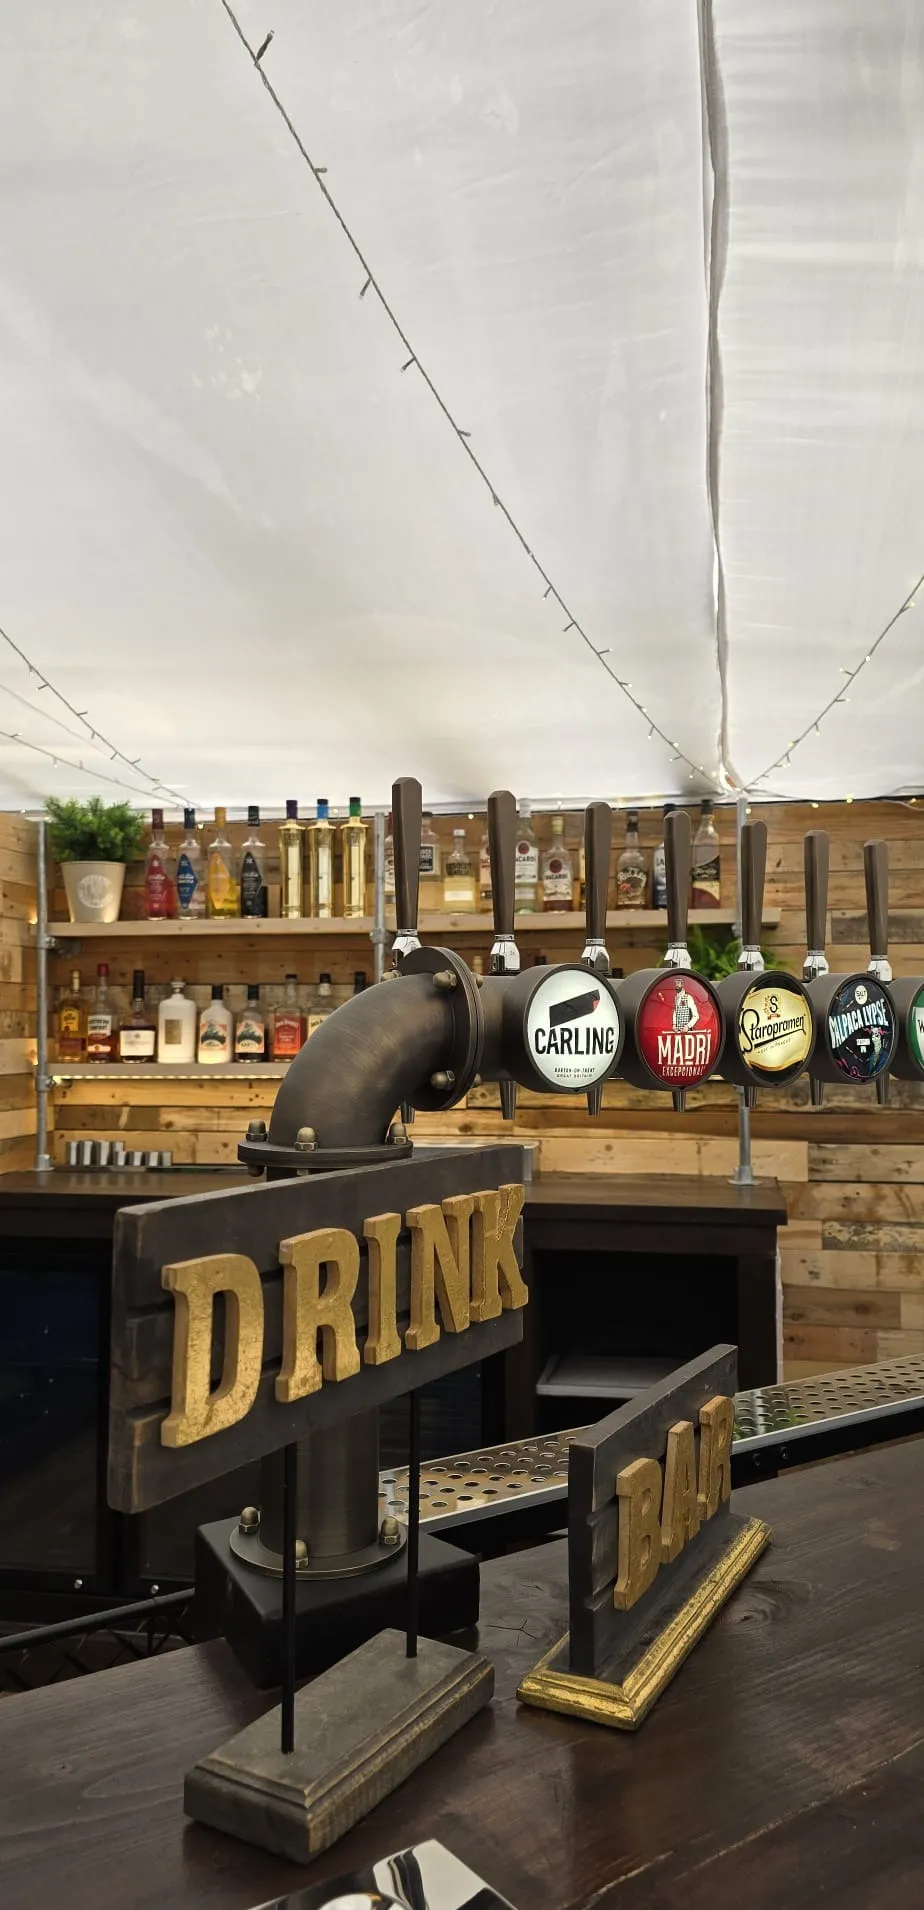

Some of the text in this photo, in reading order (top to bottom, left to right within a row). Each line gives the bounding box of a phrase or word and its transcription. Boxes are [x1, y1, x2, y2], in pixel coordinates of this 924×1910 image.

[534, 1027, 614, 1055] CARLING
[740, 1008, 805, 1055] Staropramen
[161, 1184, 528, 1448] DRINK
[614, 1395, 734, 1611] BAR
